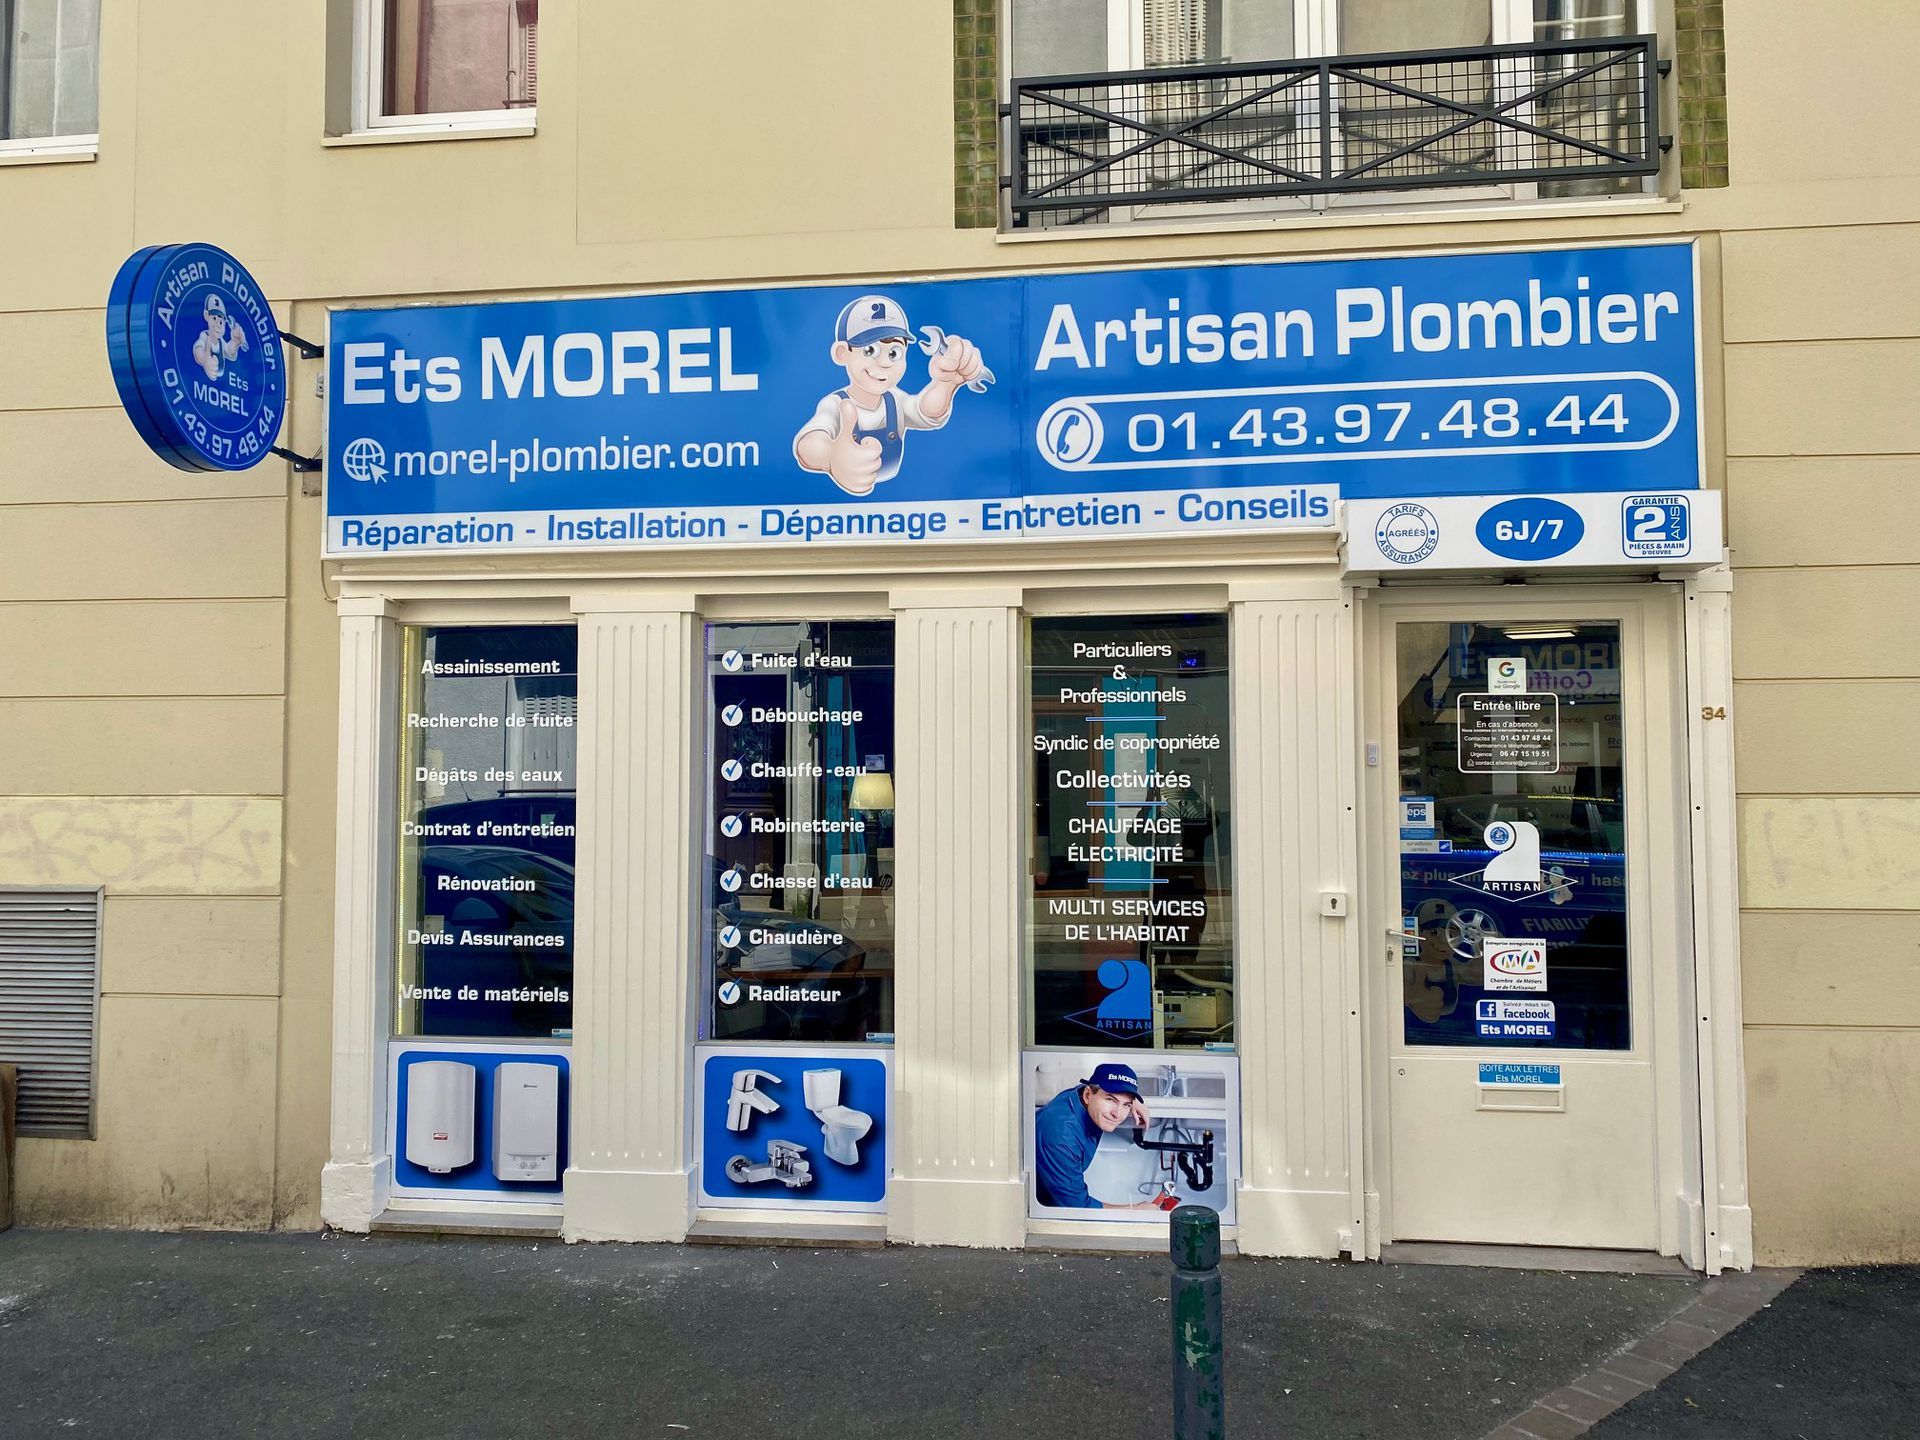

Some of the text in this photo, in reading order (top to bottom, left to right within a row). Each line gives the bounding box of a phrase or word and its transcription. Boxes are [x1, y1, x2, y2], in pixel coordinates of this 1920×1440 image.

[157, 260, 276, 370] Artisan Plombier
[1034, 276, 1679, 371] Artisan Plombier
[342, 327, 759, 405] Ets MOREL
[193, 372, 249, 417] Ets MOREL
[163, 368, 276, 459] 01.43.97.48.44
[1128, 393, 1629, 454] 01.43.97.48.44
[394, 434, 760, 482] morel-plombier.com
[1632, 497, 1679, 505] GARANTIE
[1388, 505, 1425, 517] TARIFS
[342, 516, 514, 551] Réparation
[547, 511, 727, 541] Installation
[761, 507, 947, 541] Dépannage
[982, 497, 1141, 531] Entretien
[1177, 489, 1329, 522] Conseils
[1634, 507, 1666, 540] 2
[1670, 506, 1681, 540] ANS
[1495, 519, 1564, 543] 6J/7
[1379, 537, 1436, 562] ASSURANCES
[1073, 641, 1172, 658] Particuliers
[421, 659, 560, 674] Assainissement
[751, 653, 798, 668] Fuite
[804, 652, 852, 668] d'eau
[1112, 664, 1127, 680] &
[1060, 687, 1187, 704] Professionnels
[1473, 701, 1541, 711] Entrée libre
[1702, 706, 1726, 720] 34
[407, 713, 574, 728] Recherche de fuite
[751, 707, 863, 726] Débouchage
[1033, 734, 1220, 754] Syndic de copropriété
[415, 767, 563, 786] Dégâts des eaux
[751, 763, 822, 778] Chauffe
[1056, 770, 1191, 789] Collectivités
[1407, 808, 1426, 818] eps
[402, 820, 575, 837] Contrat d'entretien
[751, 817, 866, 833] Robinetterie
[1068, 818, 1182, 834] CHAUFFAGE
[1068, 843, 1184, 863] ÉLECTRICITÉ
[437, 875, 536, 892] Rénovation
[750, 873, 873, 889] Chasse d'eau
[879, 874, 891, 890] hp
[1424, 868, 1456, 884] plus
[1483, 882, 1541, 892] ARTISAN
[1049, 900, 1205, 917] MULTI SERVICES
[407, 930, 565, 947] Devis Assurances
[749, 929, 844, 945] Chaudière
[1065, 925, 1189, 942] DE L'HABITAT
[401, 984, 569, 1003] Vente de matériels
[749, 985, 841, 1002] Radiateur
[1503, 1009, 1550, 1019] facebook
[1096, 1018, 1153, 1030] ARTISAN
[1480, 1024, 1551, 1036] Ets MOREL
[1480, 1064, 1504, 1072] BOITE
[1505, 1065, 1521, 1073] AUX
[1495, 1074, 1543, 1083] Ets MOREL
